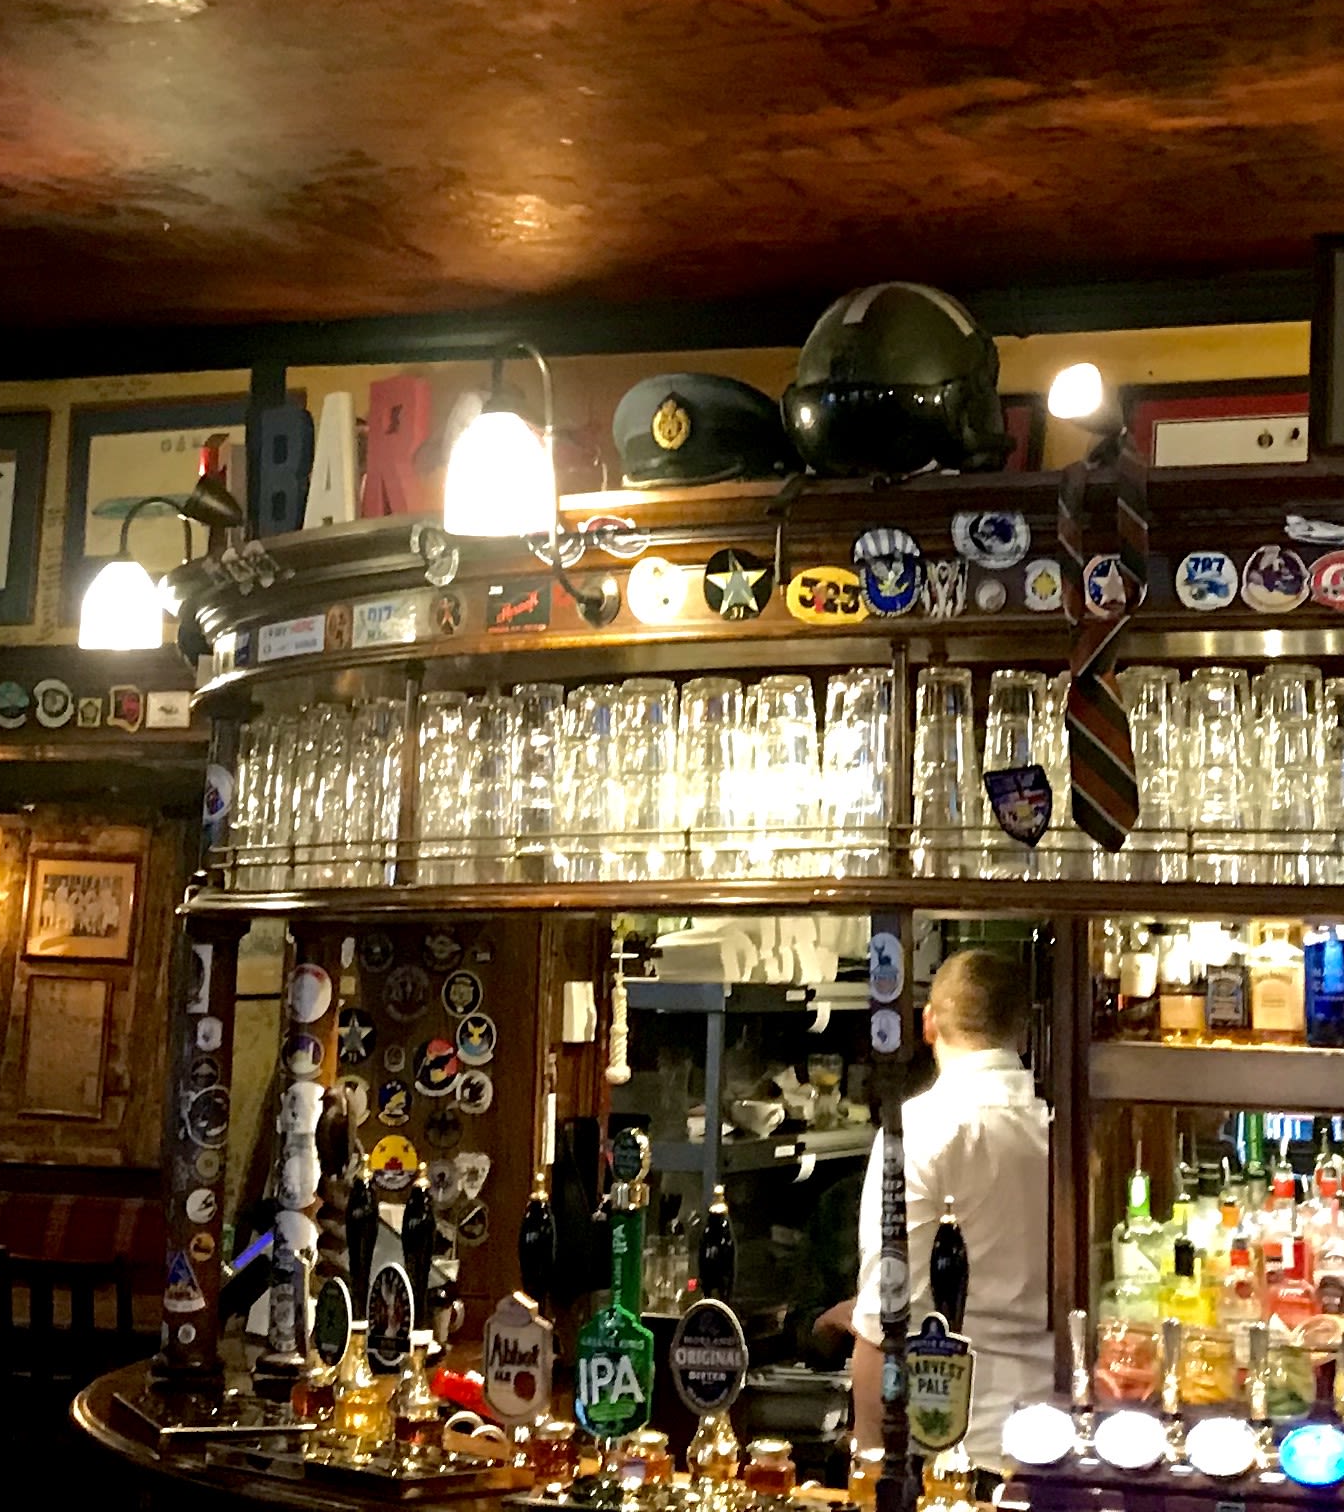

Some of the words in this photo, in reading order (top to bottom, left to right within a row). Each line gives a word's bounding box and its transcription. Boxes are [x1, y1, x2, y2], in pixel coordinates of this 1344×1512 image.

[257, 375, 431, 537] BAR
[674, 1348, 742, 1366] ORIGINAL
[579, 1355, 645, 1405] IPA
[917, 1378, 950, 1396] PALE
